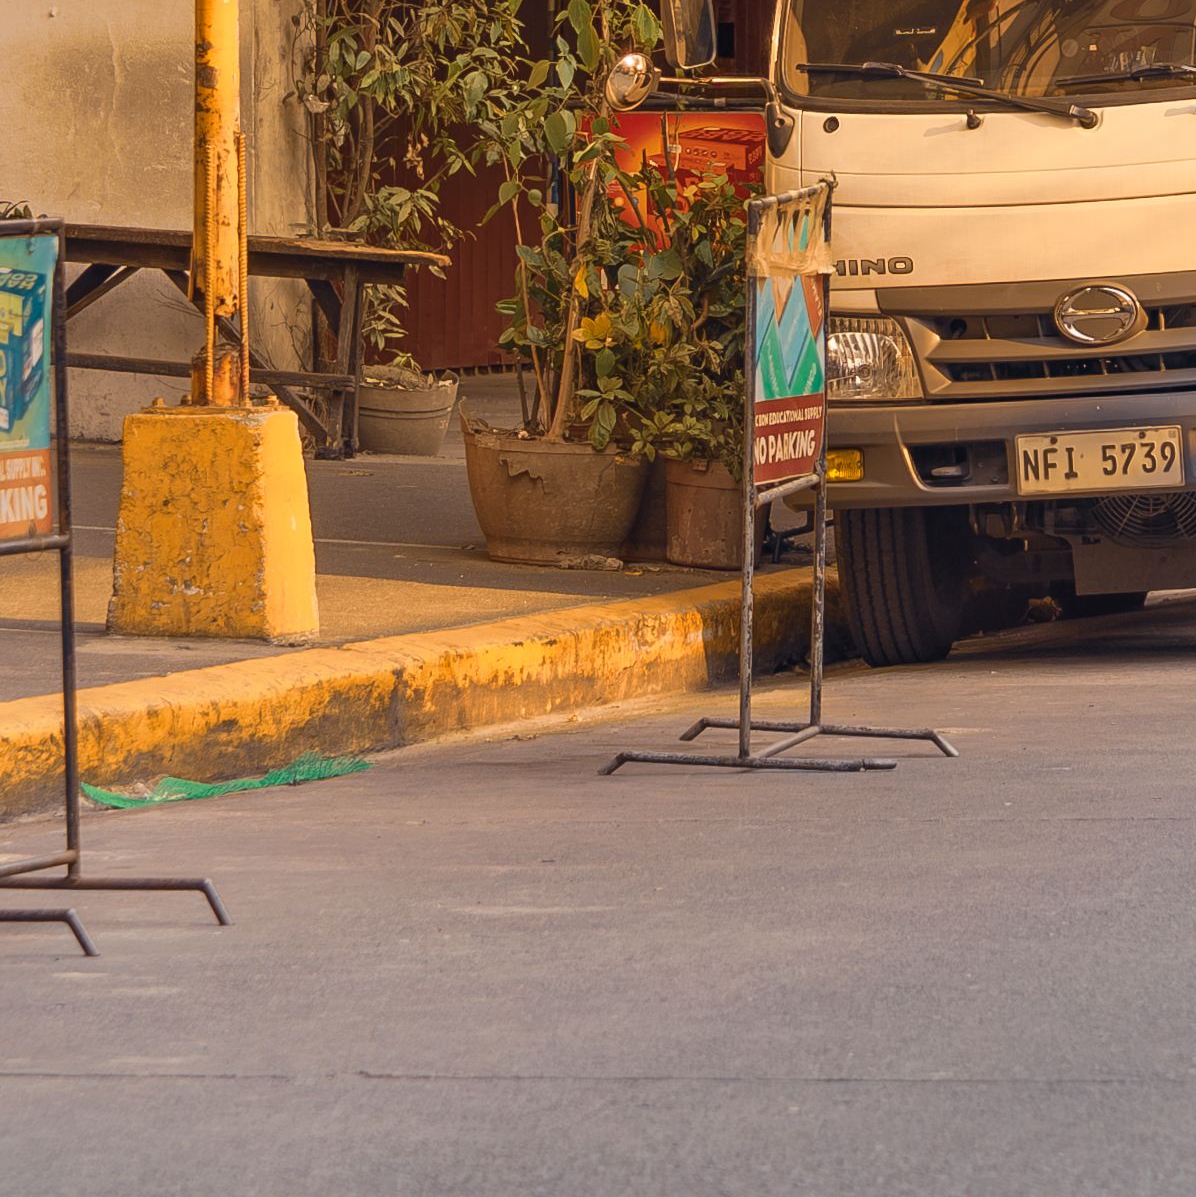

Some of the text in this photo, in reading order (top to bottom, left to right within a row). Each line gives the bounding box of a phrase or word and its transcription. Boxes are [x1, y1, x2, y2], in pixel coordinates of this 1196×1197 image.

[769, 408, 804, 426] EDUCATIONAL
[804, 406, 823, 421] SUPPLY
[754, 429, 816, 465] NO PARKING
[1023, 441, 1176, 481] NFI 5739
